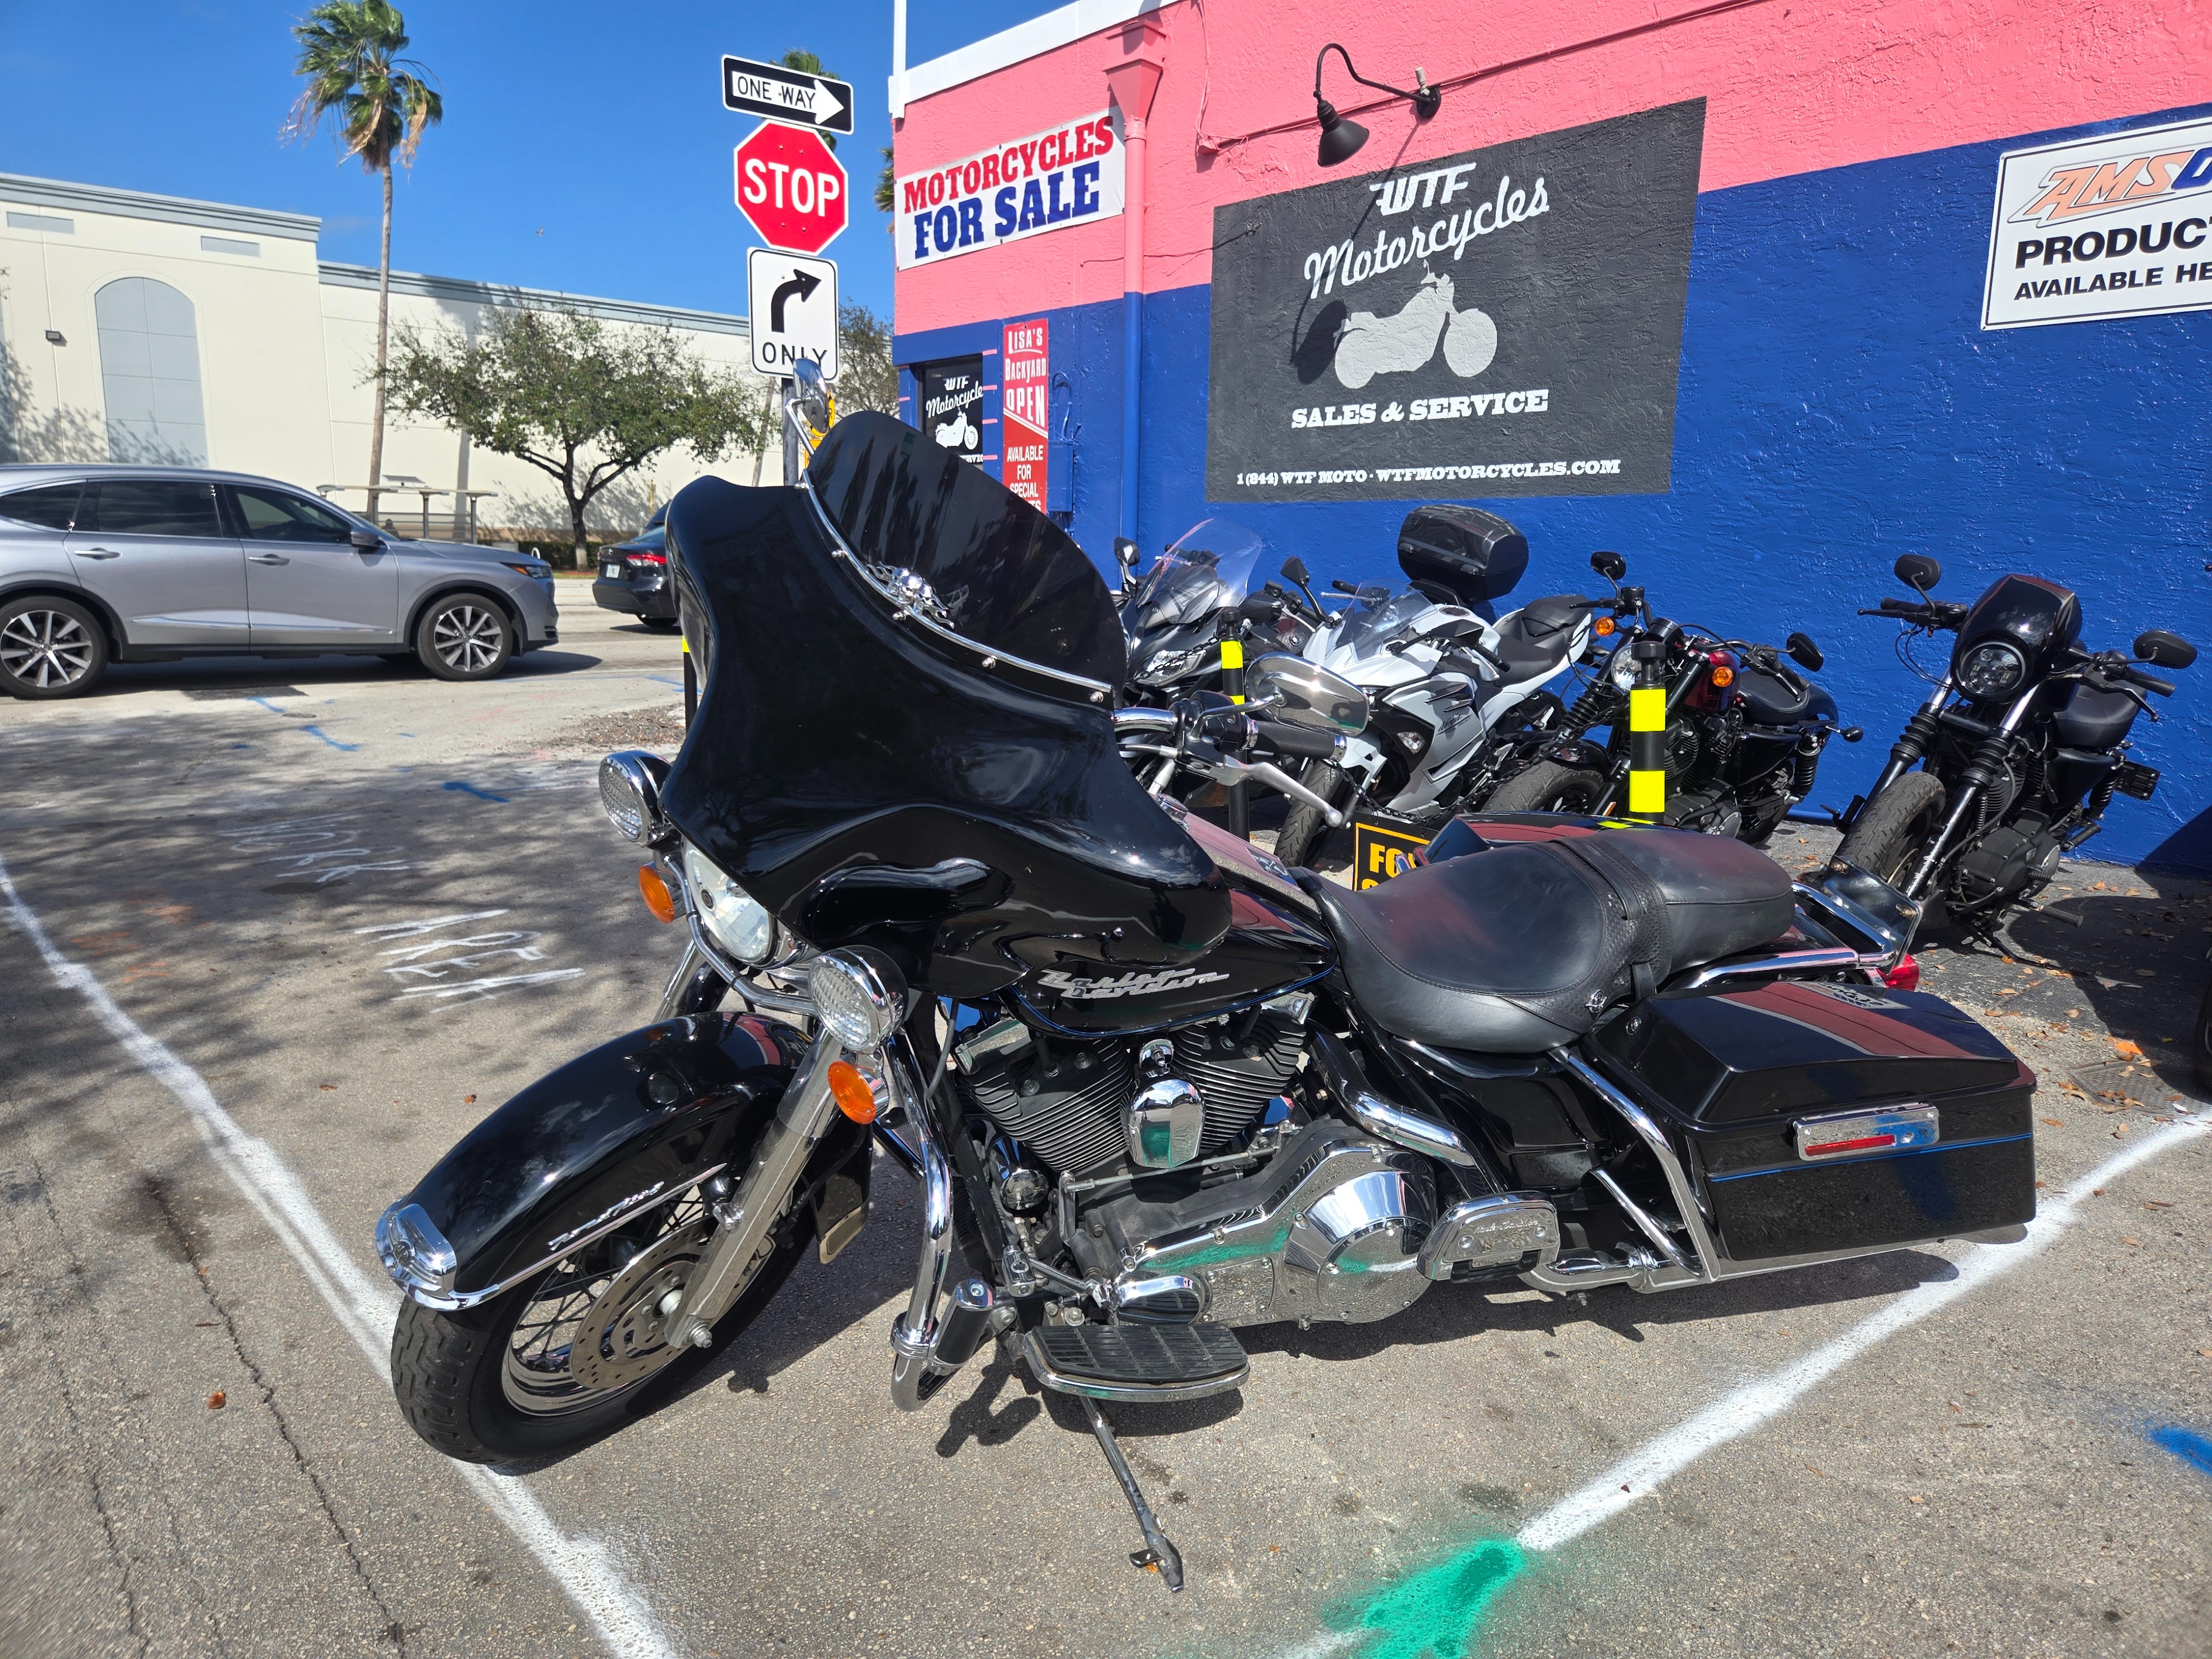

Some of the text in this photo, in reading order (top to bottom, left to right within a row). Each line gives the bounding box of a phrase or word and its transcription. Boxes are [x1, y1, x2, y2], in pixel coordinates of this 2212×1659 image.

[737, 76, 816, 109] ONE WAY
[904, 116, 1114, 214] MOTORCYCLES
[744, 159, 839, 217] STOP
[1369, 162, 1477, 216] WTF
[914, 160, 1100, 259] FOR SALE
[1303, 174, 1550, 299] Motorcycles
[2015, 216, 2212, 269] PRODUC
[2013, 267, 2164, 301] AVAILABLE
[1008, 327, 1043, 354] LISA'S
[1006, 385, 1045, 427] OPEN
[1291, 389, 1549, 429] SALES & SERVICE
[1006, 445, 1044, 462] AVAILABLE
[1017, 465, 1032, 480] FOR
[1281, 472, 1316, 484] WTF
[1318, 470, 1367, 483] MOTO
[1376, 459, 1621, 482] WTFMOTORCYCLES.COM
[1009, 482, 1039, 498] SPECIAL
